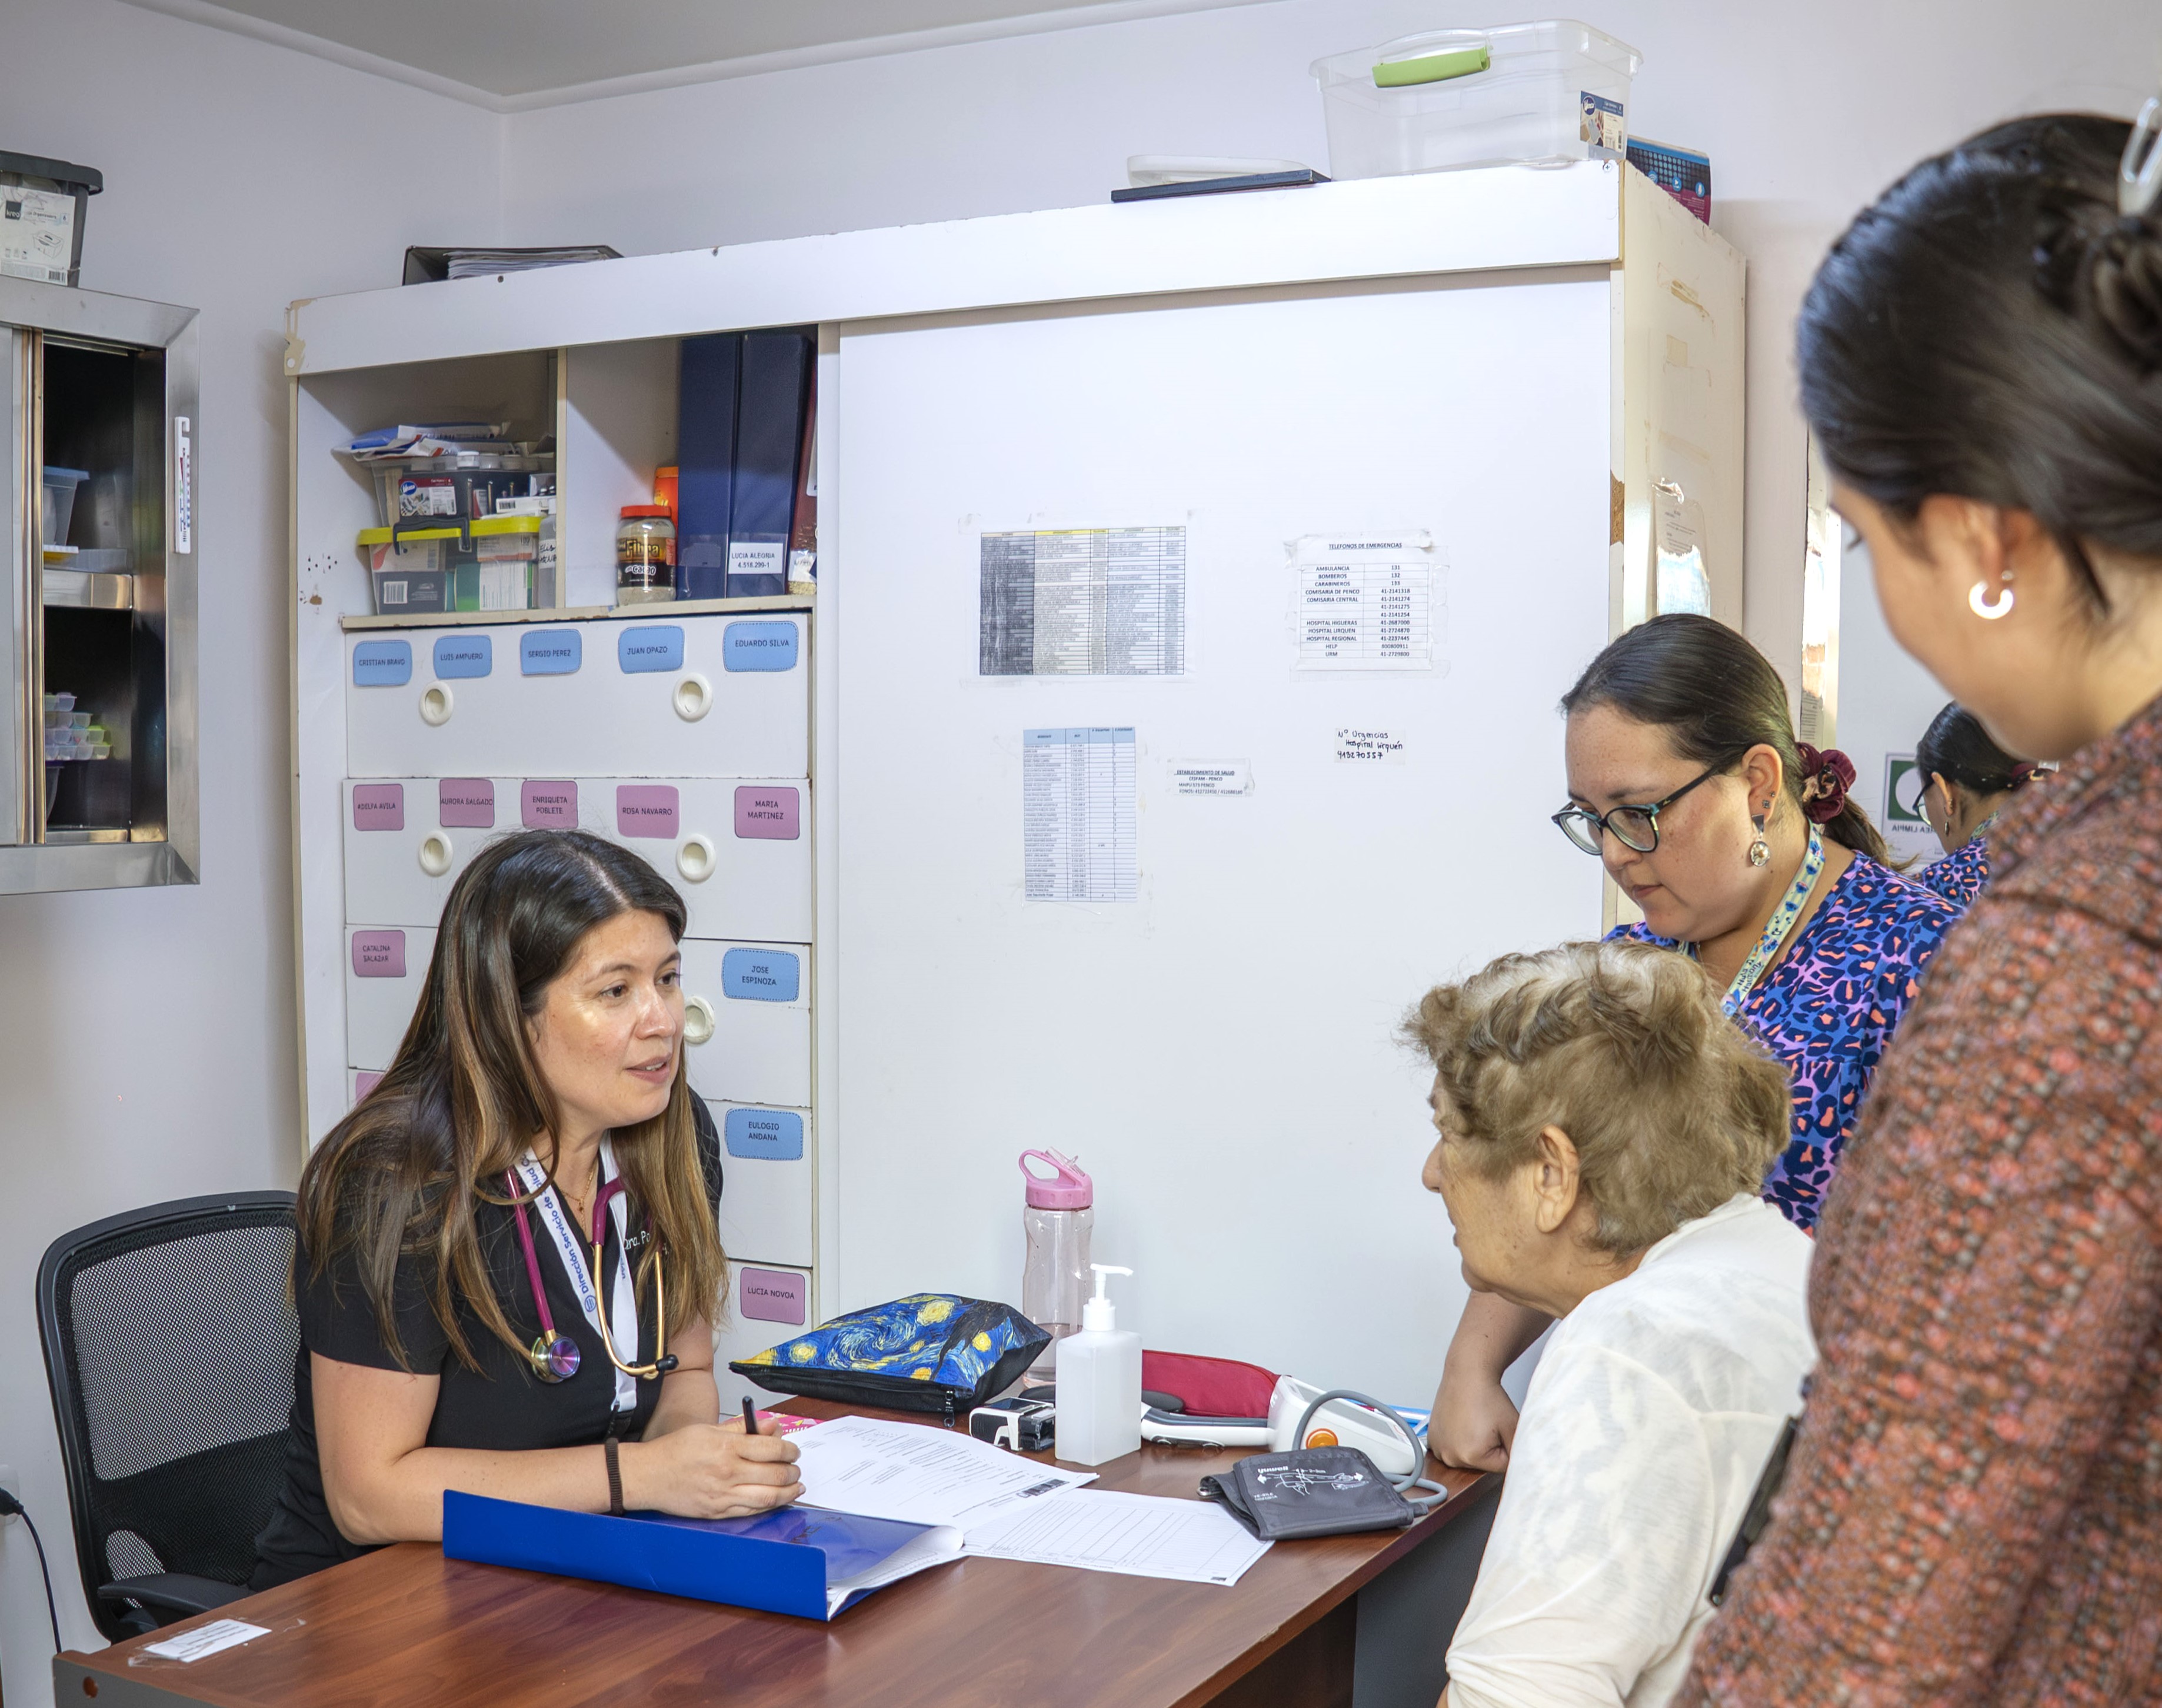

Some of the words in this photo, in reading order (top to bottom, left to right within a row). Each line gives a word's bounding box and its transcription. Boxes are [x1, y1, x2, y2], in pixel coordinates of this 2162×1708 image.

[552, 649, 571, 657] PEREZ
[646, 646, 668, 654] OPAZO
[1352, 730, 1388, 741] Urgencias
[532, 796, 568, 804] ENRIQUETA
[748, 811, 784, 820] MARTINEZ
[751, 965, 769, 974] JOSE
[742, 975, 777, 985] ESPINOZA
[748, 1121, 780, 1130] EULOGIO
[748, 1133, 778, 1141] ANDANA
[544, 1196, 554, 1210] de
[552, 1210, 572, 1249] Servicio
[568, 1248, 589, 1294] Dirección
[747, 1287, 768, 1296] LUCIA
[770, 1290, 795, 1299] NOVOA
